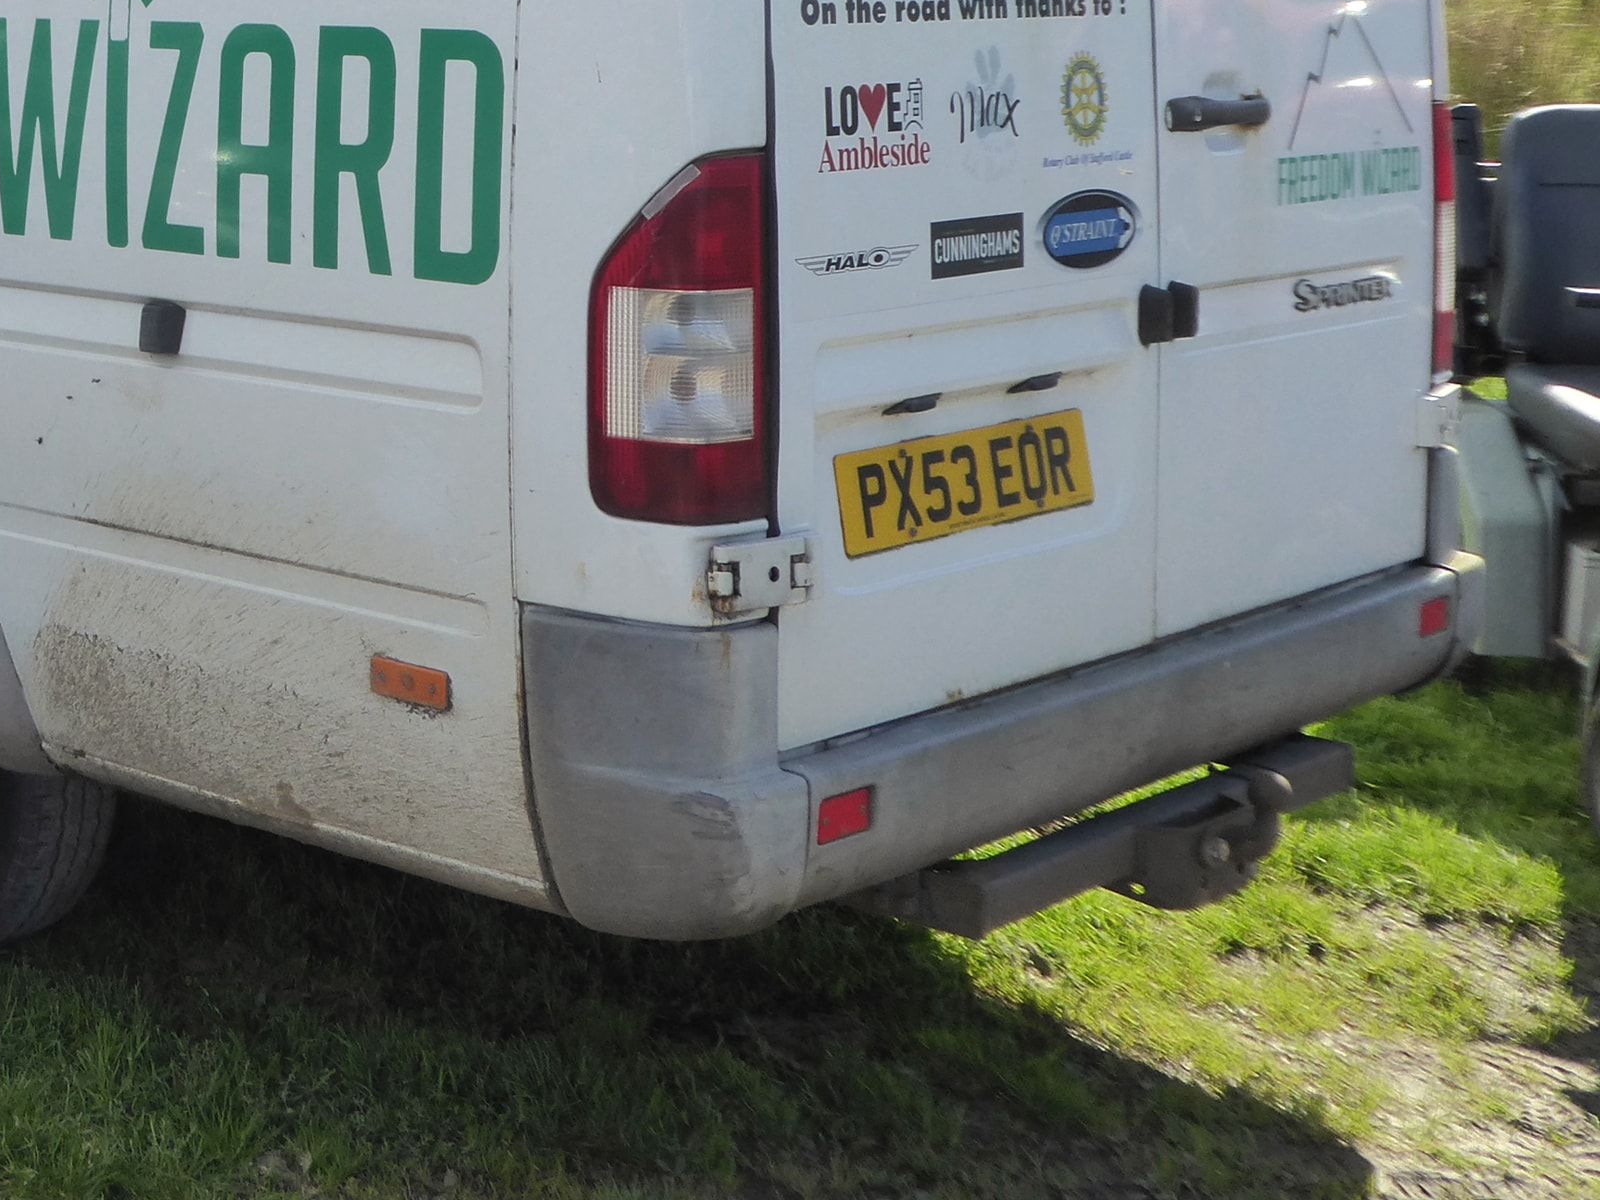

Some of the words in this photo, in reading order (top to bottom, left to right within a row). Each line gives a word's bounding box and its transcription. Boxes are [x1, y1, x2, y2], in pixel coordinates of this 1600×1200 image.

[818, 133, 931, 174] Ambleside
[1278, 152, 1355, 206] FREEDOM
[1361, 146, 1421, 197] WIZARD
[825, 248, 891, 272] HALO
[934, 229, 1021, 264] CUNNINGHAMS
[857, 445, 982, 539] PX53
